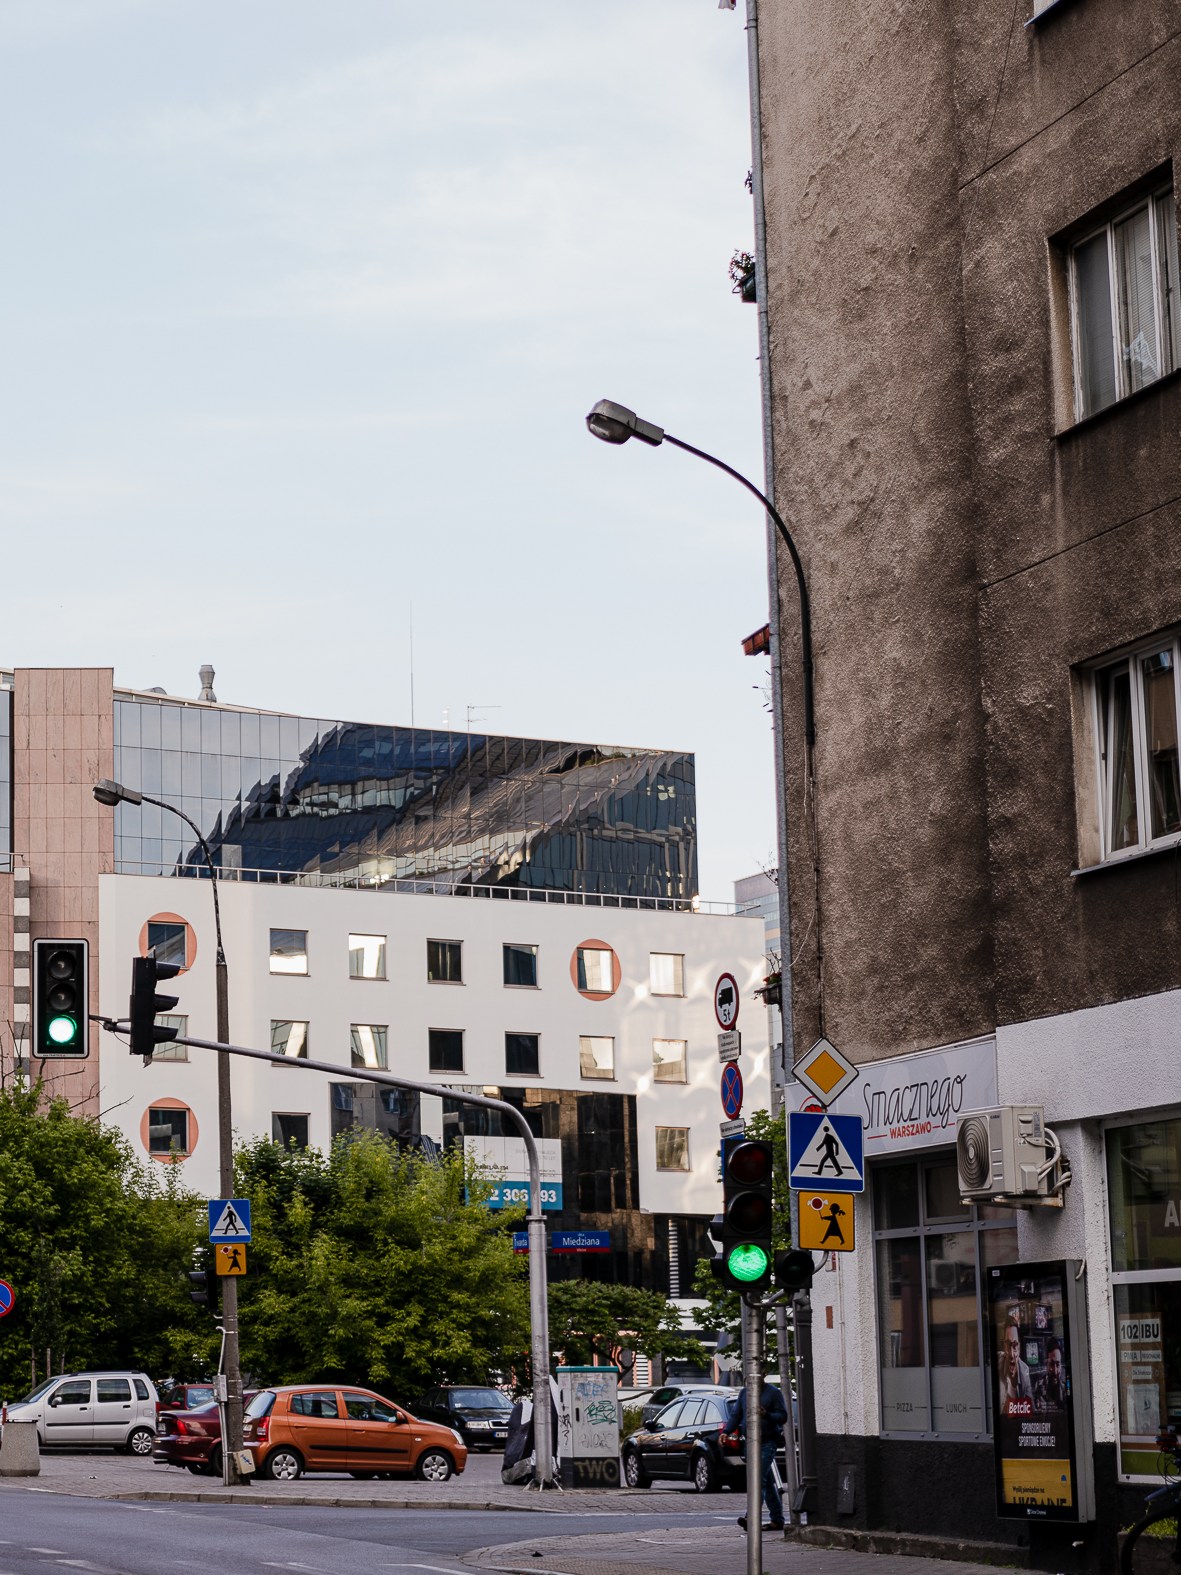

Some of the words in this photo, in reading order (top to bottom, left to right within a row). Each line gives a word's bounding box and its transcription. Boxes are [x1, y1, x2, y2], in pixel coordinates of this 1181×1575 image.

[723, 1008, 731, 1023] 5t
[862, 1073, 967, 1130] Smacznego
[889, 1121, 932, 1139] WARSZAWO
[562, 1237, 600, 1246] Miedziana
[1121, 1324, 1139, 1340] 102
[1141, 1323, 1159, 1339] IBU
[896, 1402, 913, 1412] PIZZA
[946, 1403, 967, 1413] LUNCH
[1008, 1401, 1031, 1414] Betclic
[1018, 1436, 1039, 1447] SPORTOWE
[574, 1459, 619, 1482] TWO
